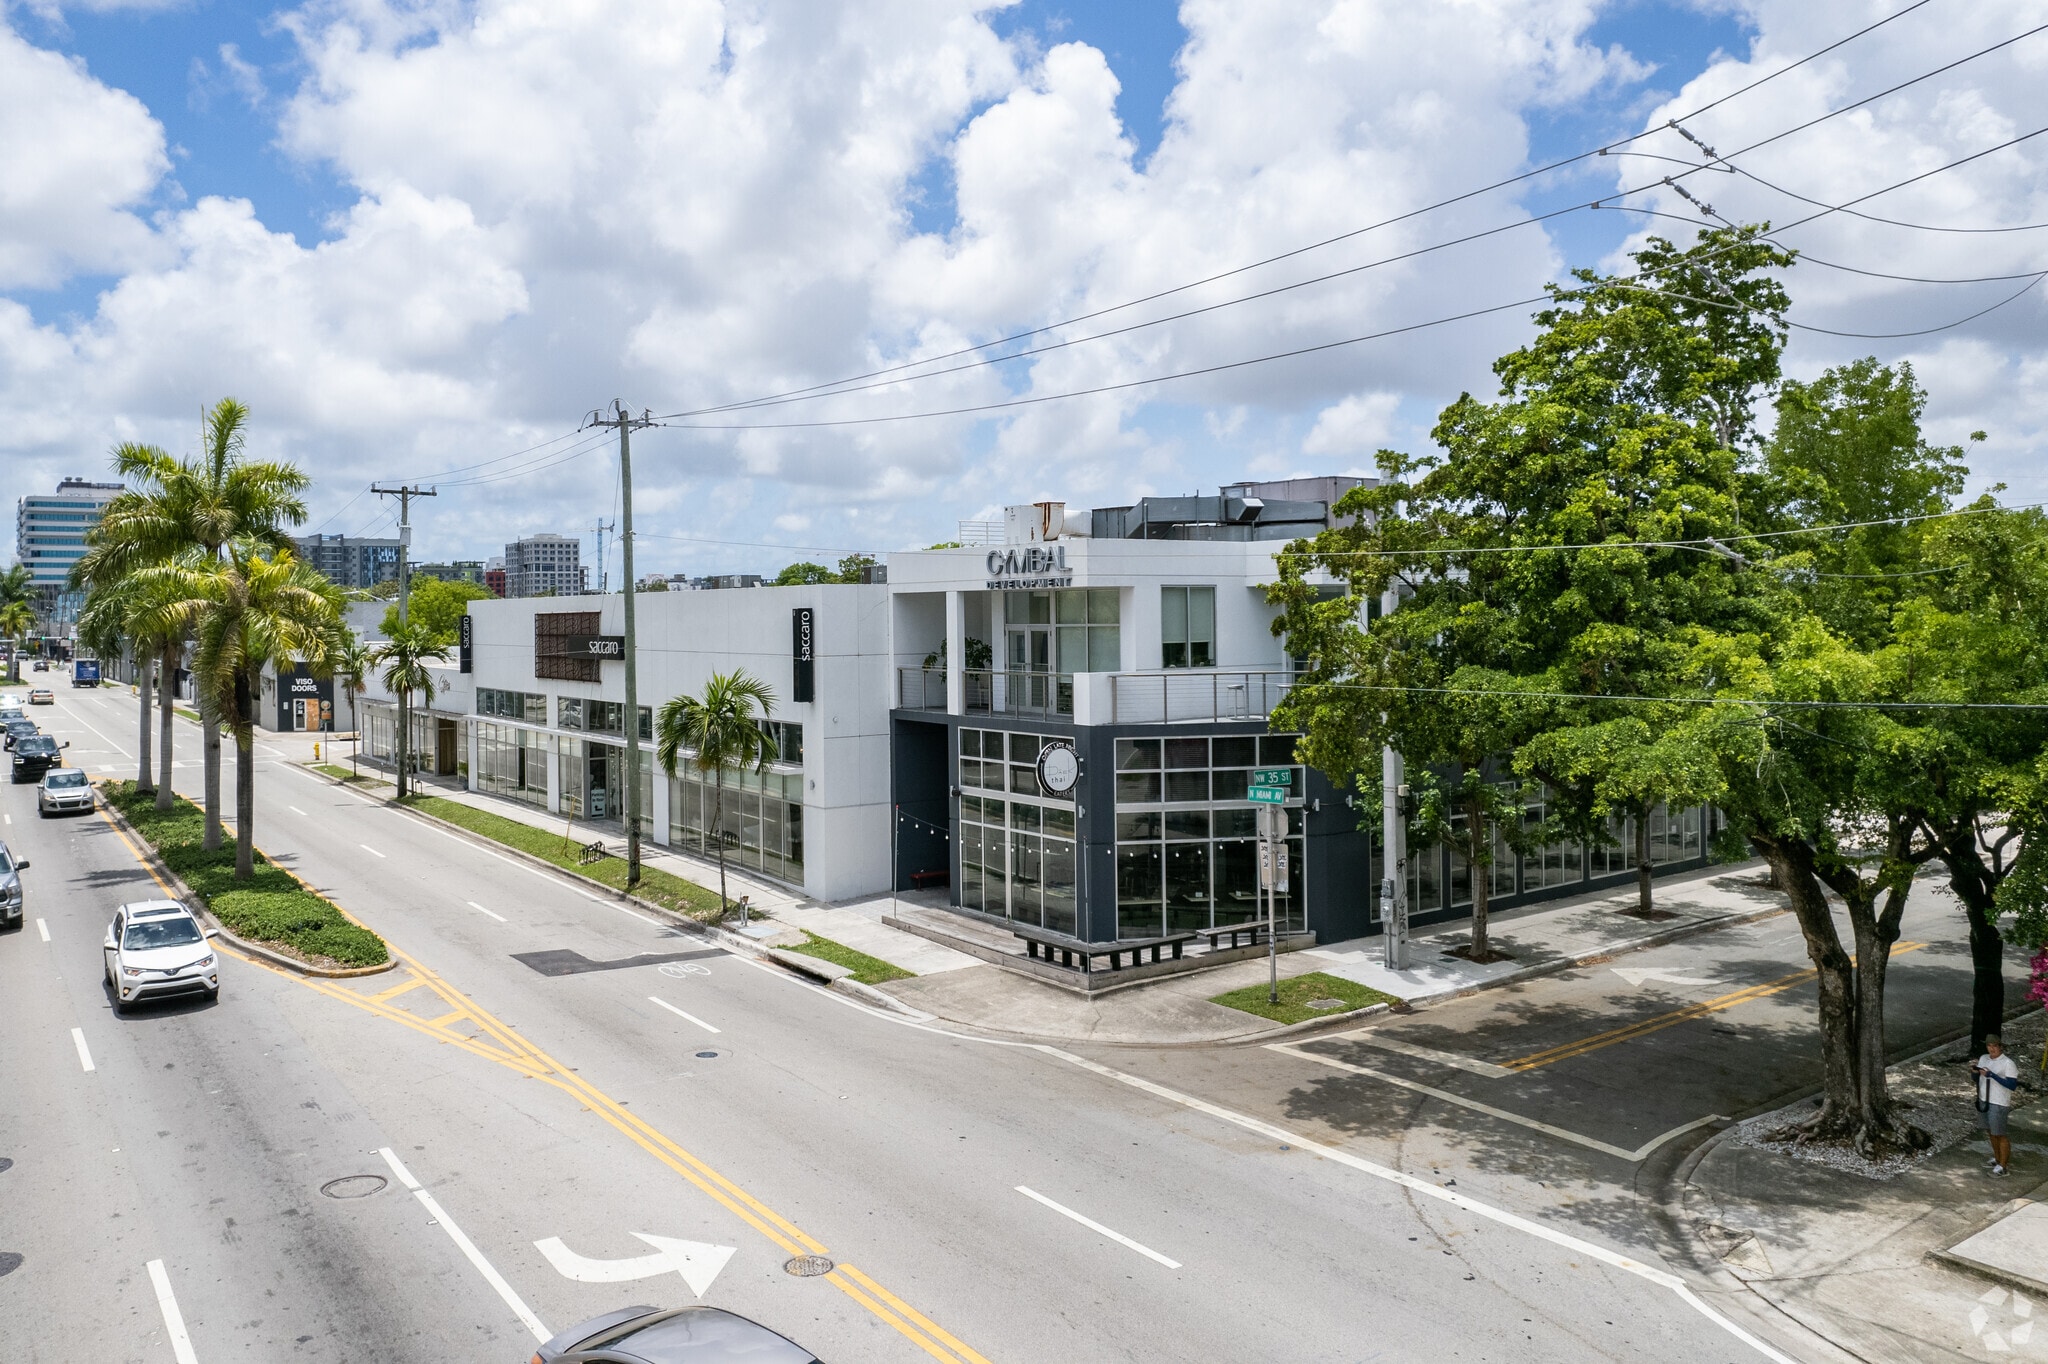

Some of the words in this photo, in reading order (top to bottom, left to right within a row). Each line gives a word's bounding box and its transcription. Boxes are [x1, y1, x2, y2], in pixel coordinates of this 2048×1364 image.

[986, 546, 1073, 576] CYMBAL
[986, 577, 1073, 589] DEVELOPMENT
[801, 611, 810, 662] saccaro
[589, 641, 618, 654] saccaro
[1054, 742, 1065, 750] LATE
[1255, 774, 1265, 783] NW
[1268, 772, 1278, 783] 35
[1281, 772, 1289, 781] ST
[1249, 790, 1254, 798] N
[1256, 790, 1272, 800] MIAMI
[1274, 791, 1282, 800] AV
